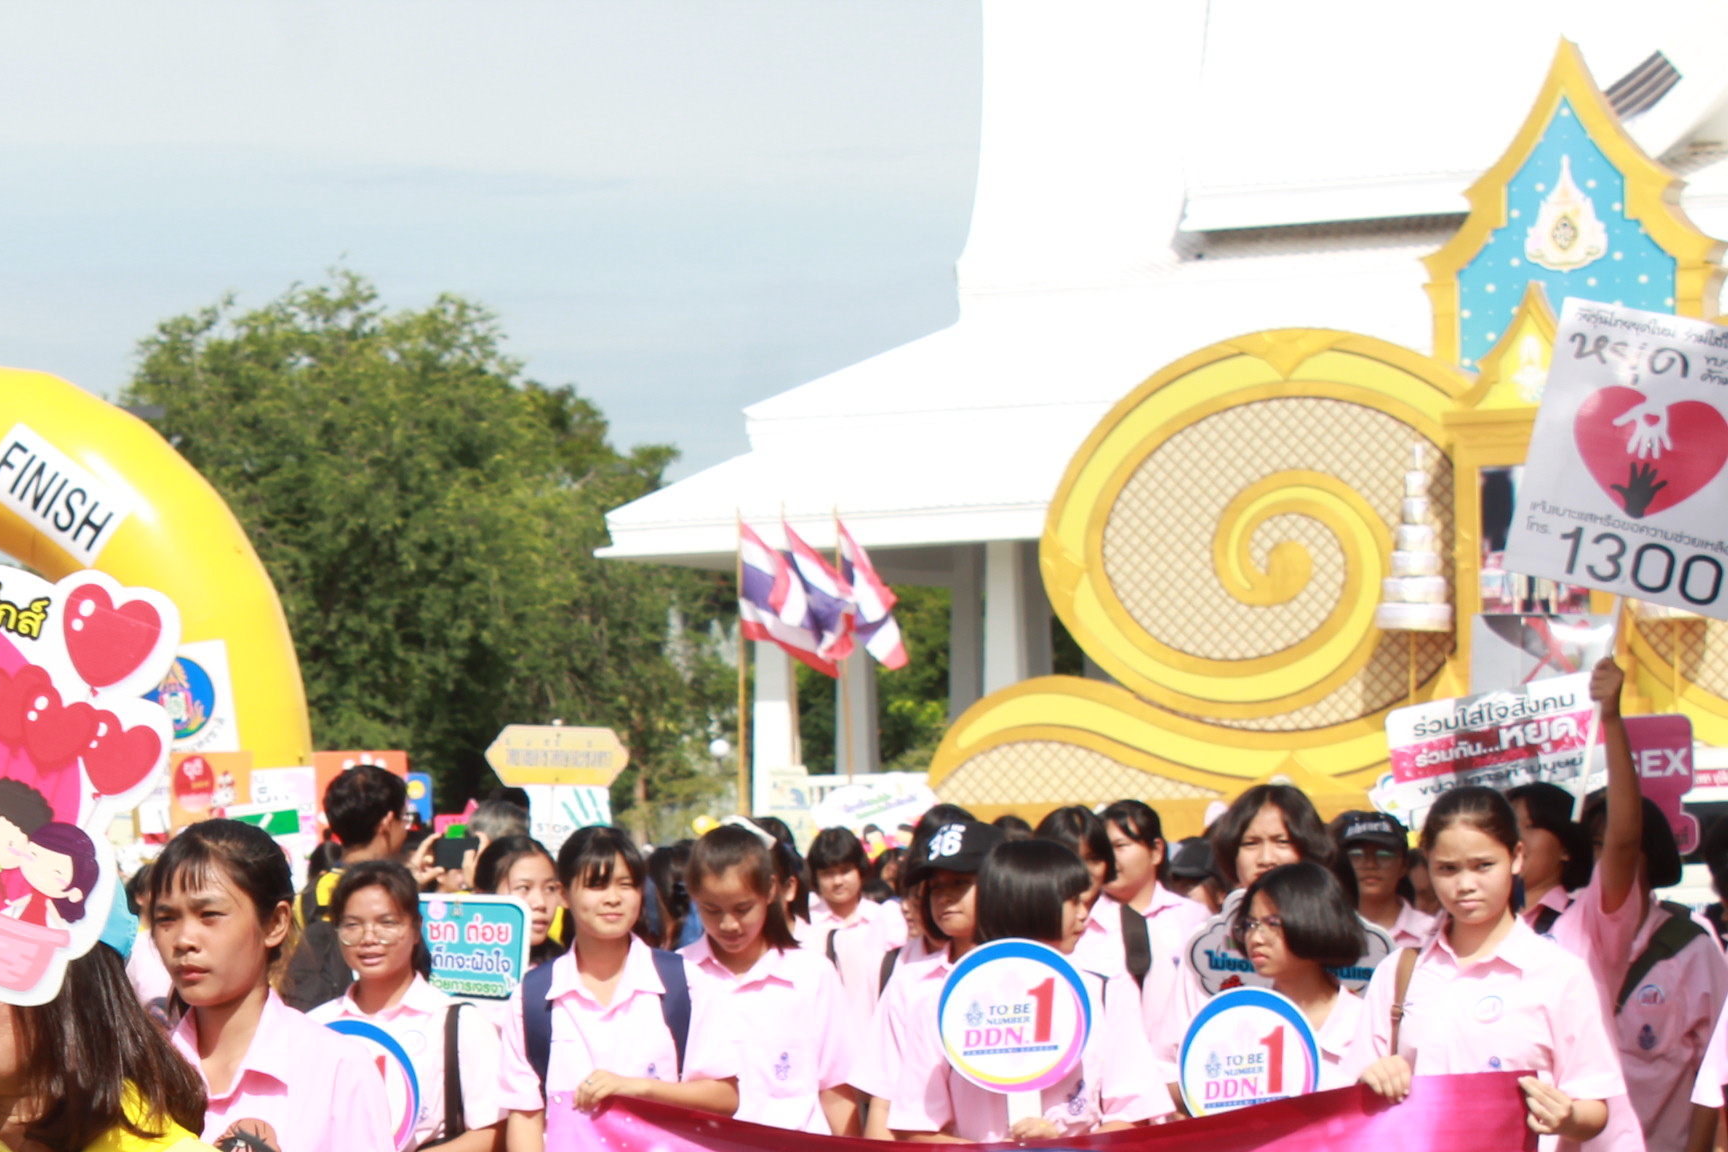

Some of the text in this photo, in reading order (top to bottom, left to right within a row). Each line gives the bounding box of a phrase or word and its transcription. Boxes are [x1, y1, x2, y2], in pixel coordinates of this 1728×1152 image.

[1560, 526, 1723, 605] 1300
[1413, 692, 1576, 738] ร่วมใส่ใจสังคม
[467, 915, 509, 942] ต่อย
[432, 946, 511, 972] ด็กจะฝังใจ
[989, 1004, 1008, 1016] TO
[1013, 1003, 1031, 1014] BE
[1226, 1055, 1243, 1066] TO
[1247, 1053, 1264, 1064] BE
